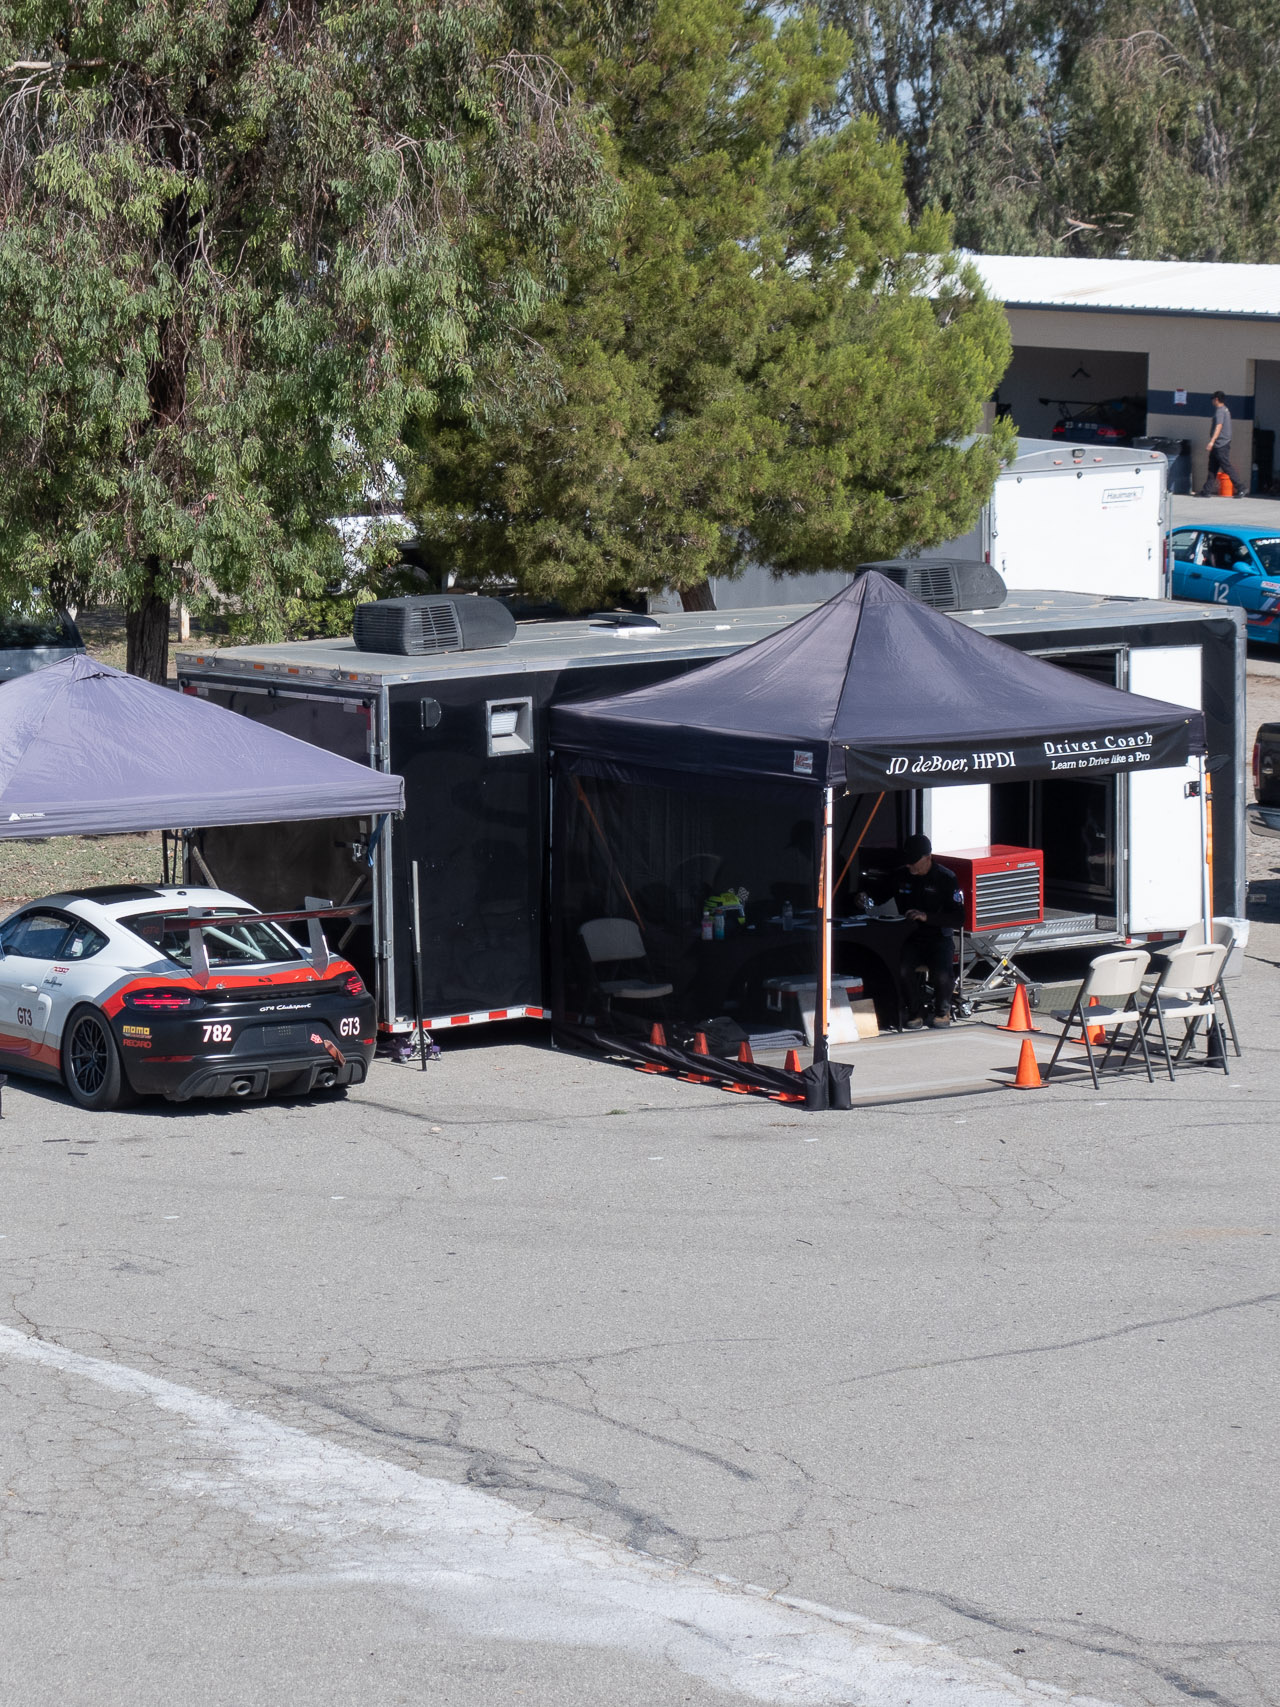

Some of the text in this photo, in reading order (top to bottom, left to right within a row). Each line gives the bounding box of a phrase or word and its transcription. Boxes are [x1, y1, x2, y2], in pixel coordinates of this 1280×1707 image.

[1214, 582, 1229, 603] 12
[1043, 731, 1153, 755] Driver Coach
[885, 751, 1017, 775] JD deBoer, HPDI
[1050, 752, 1151, 770] Learn to Drive like a Pro
[17, 1007, 33, 1026] GT3
[202, 1024, 232, 1043] 782
[340, 1017, 360, 1036] GT3
[123, 1038, 152, 1049] RECARO
